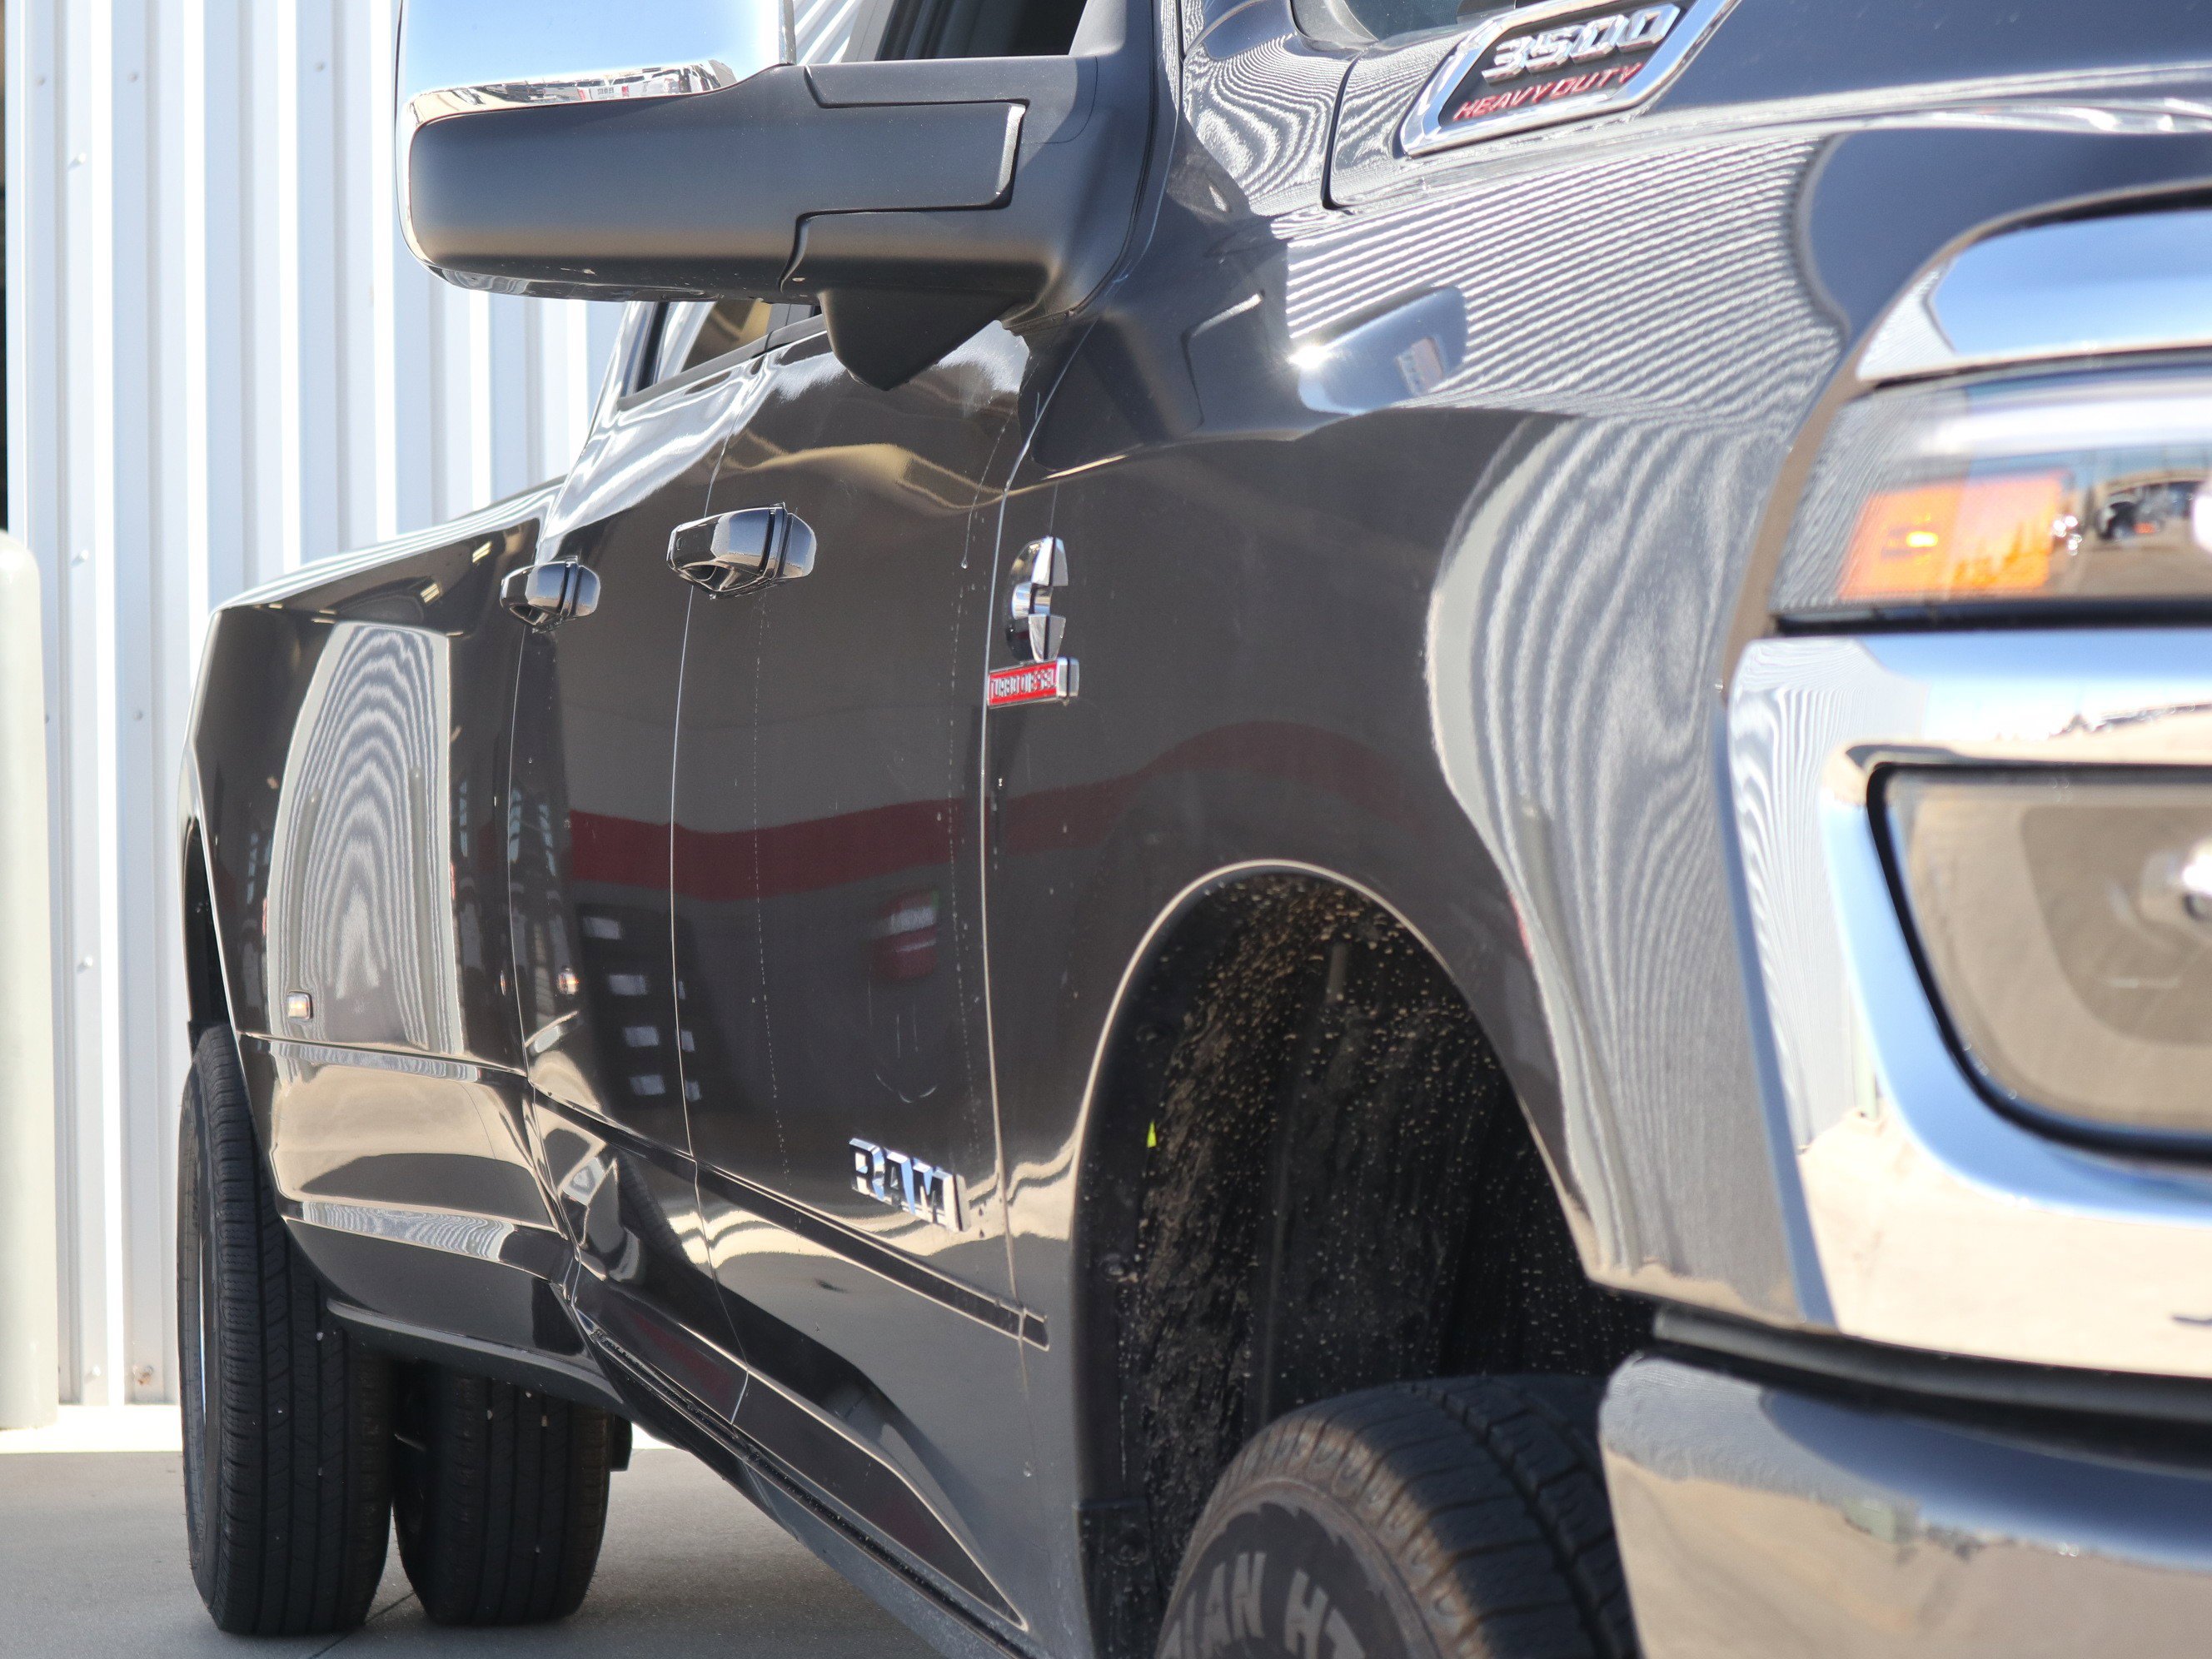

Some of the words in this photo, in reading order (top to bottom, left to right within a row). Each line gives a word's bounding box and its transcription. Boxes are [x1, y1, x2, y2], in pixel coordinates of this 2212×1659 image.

[1482, 3, 1680, 82] 3500
[1453, 81, 1552, 122] HEAVY
[1551, 62, 1644, 97] DUTY
[849, 1138, 967, 1233] RAM
